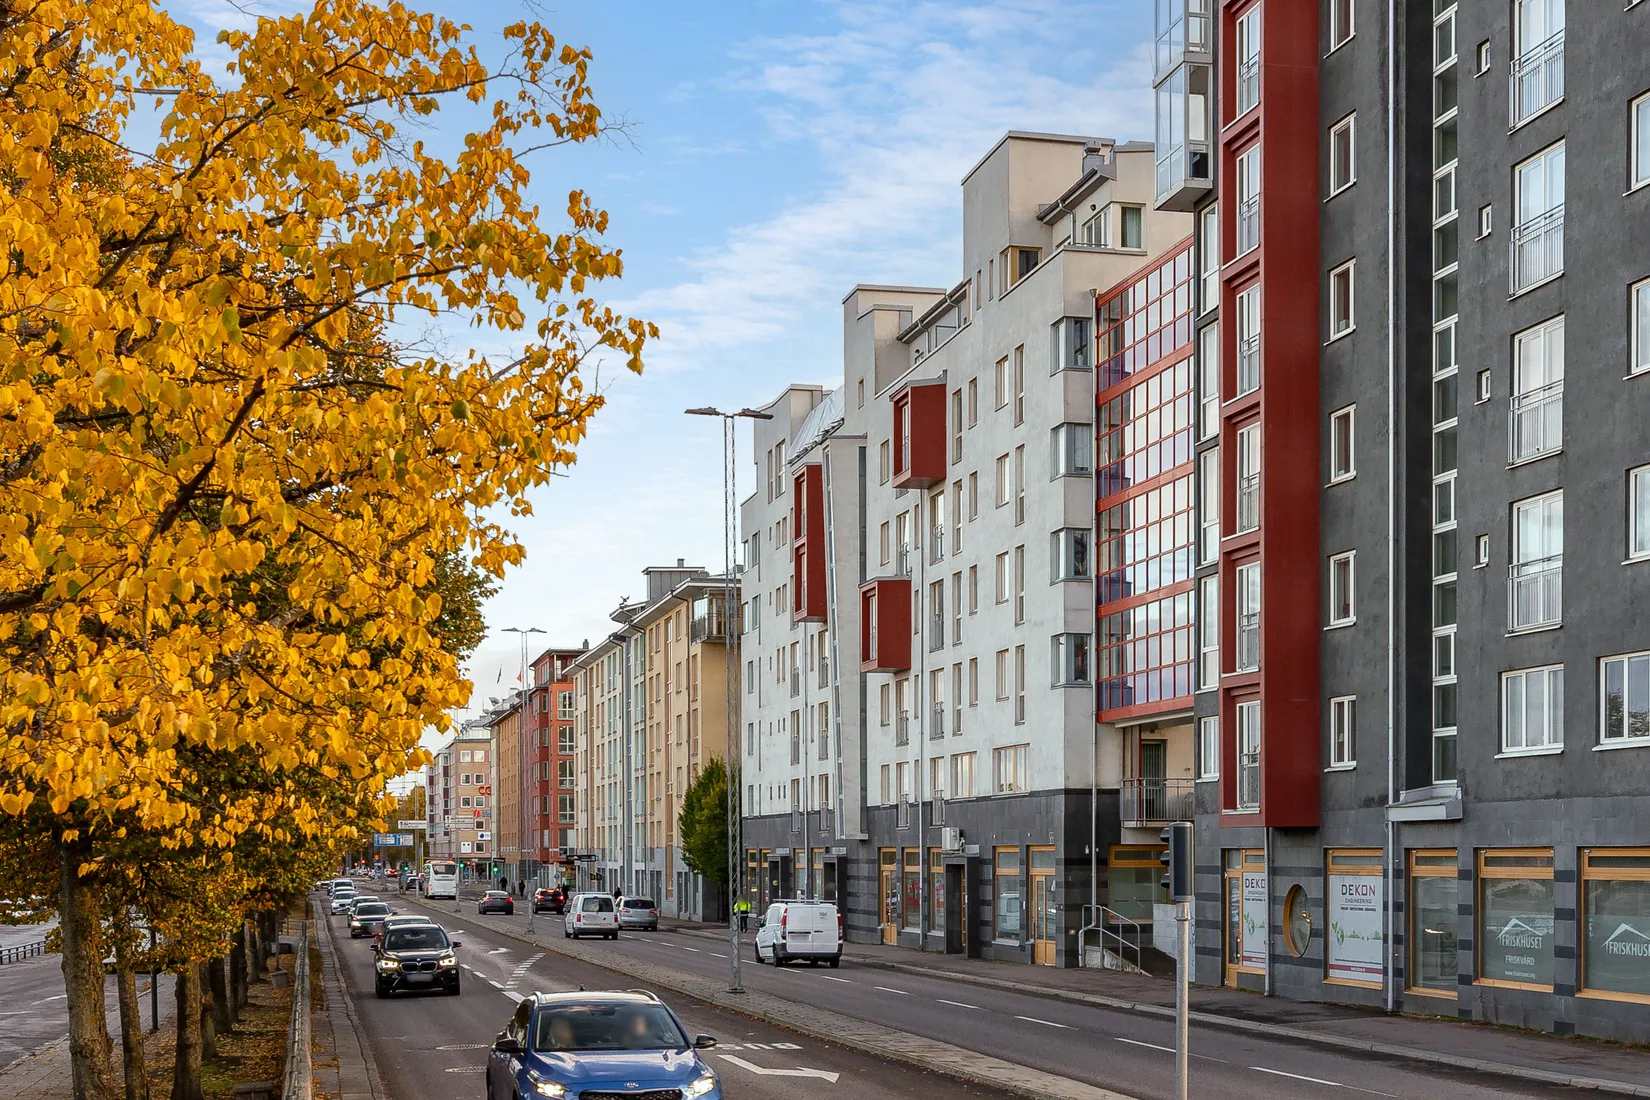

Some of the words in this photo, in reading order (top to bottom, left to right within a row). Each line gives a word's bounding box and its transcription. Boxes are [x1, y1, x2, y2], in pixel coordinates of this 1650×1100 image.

[1245, 878, 1266, 889] DEKO
[1341, 884, 1376, 896] DEKON
[1501, 934, 1543, 949] FRISKHUSET
[1608, 941, 1650, 957] FRISKHUS
